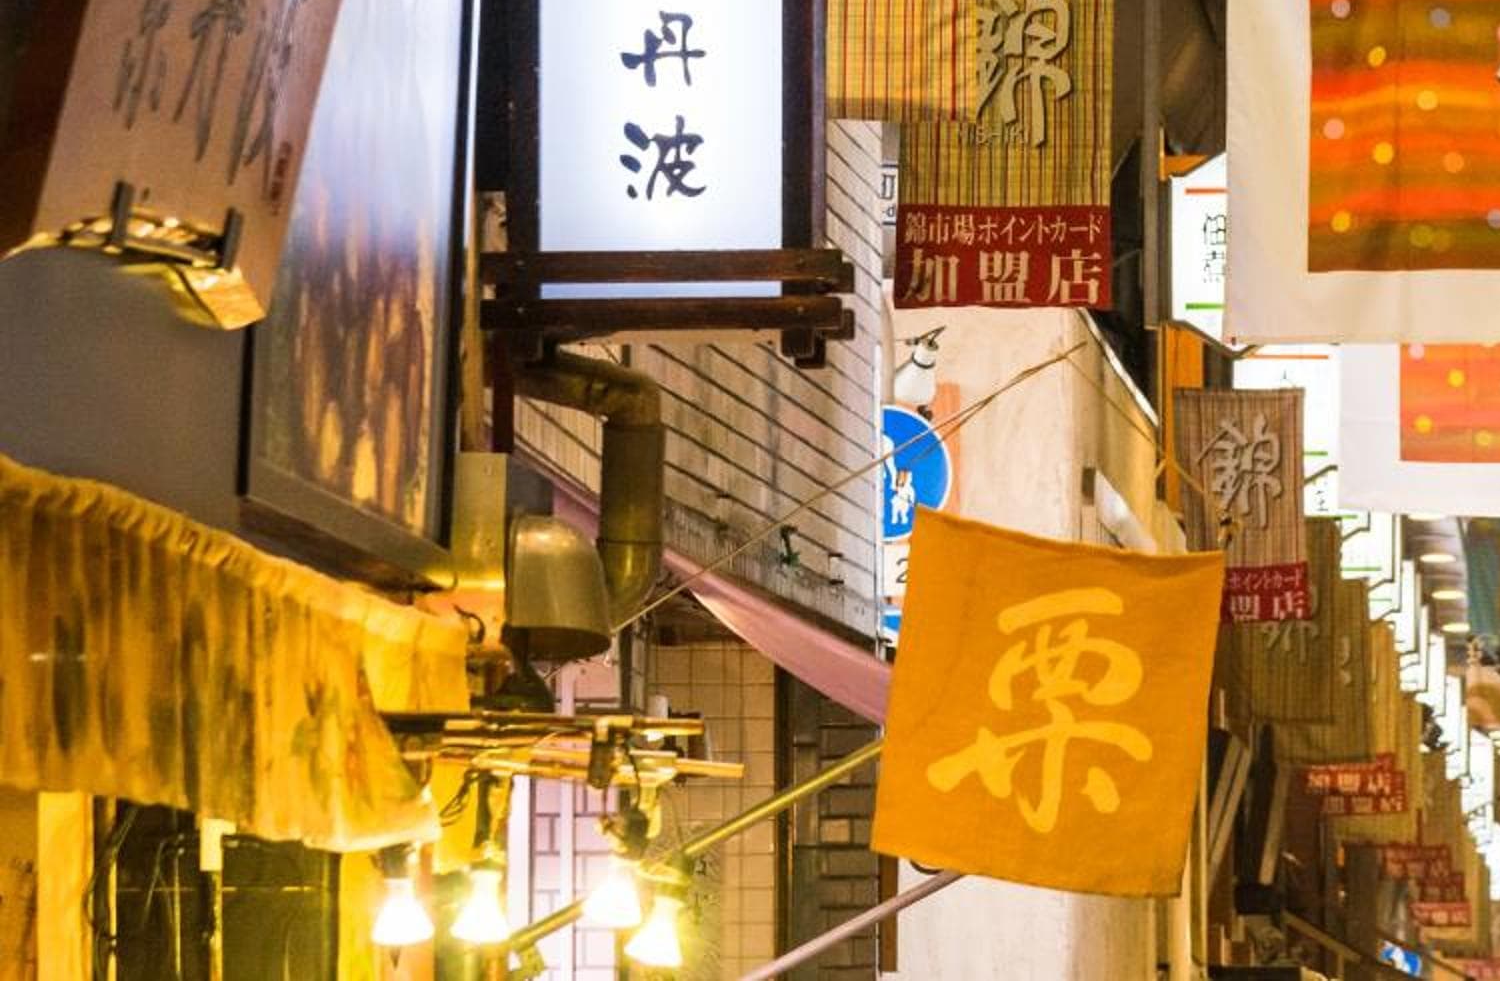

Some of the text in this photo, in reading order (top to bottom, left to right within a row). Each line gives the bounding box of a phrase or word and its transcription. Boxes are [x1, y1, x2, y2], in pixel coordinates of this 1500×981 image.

[905, 211, 1103, 246] 錦市場ポイントカード
[905, 249, 1102, 306] 加盟店
[1197, 411, 1283, 531] 錦
[927, 585, 1153, 833] 栗
